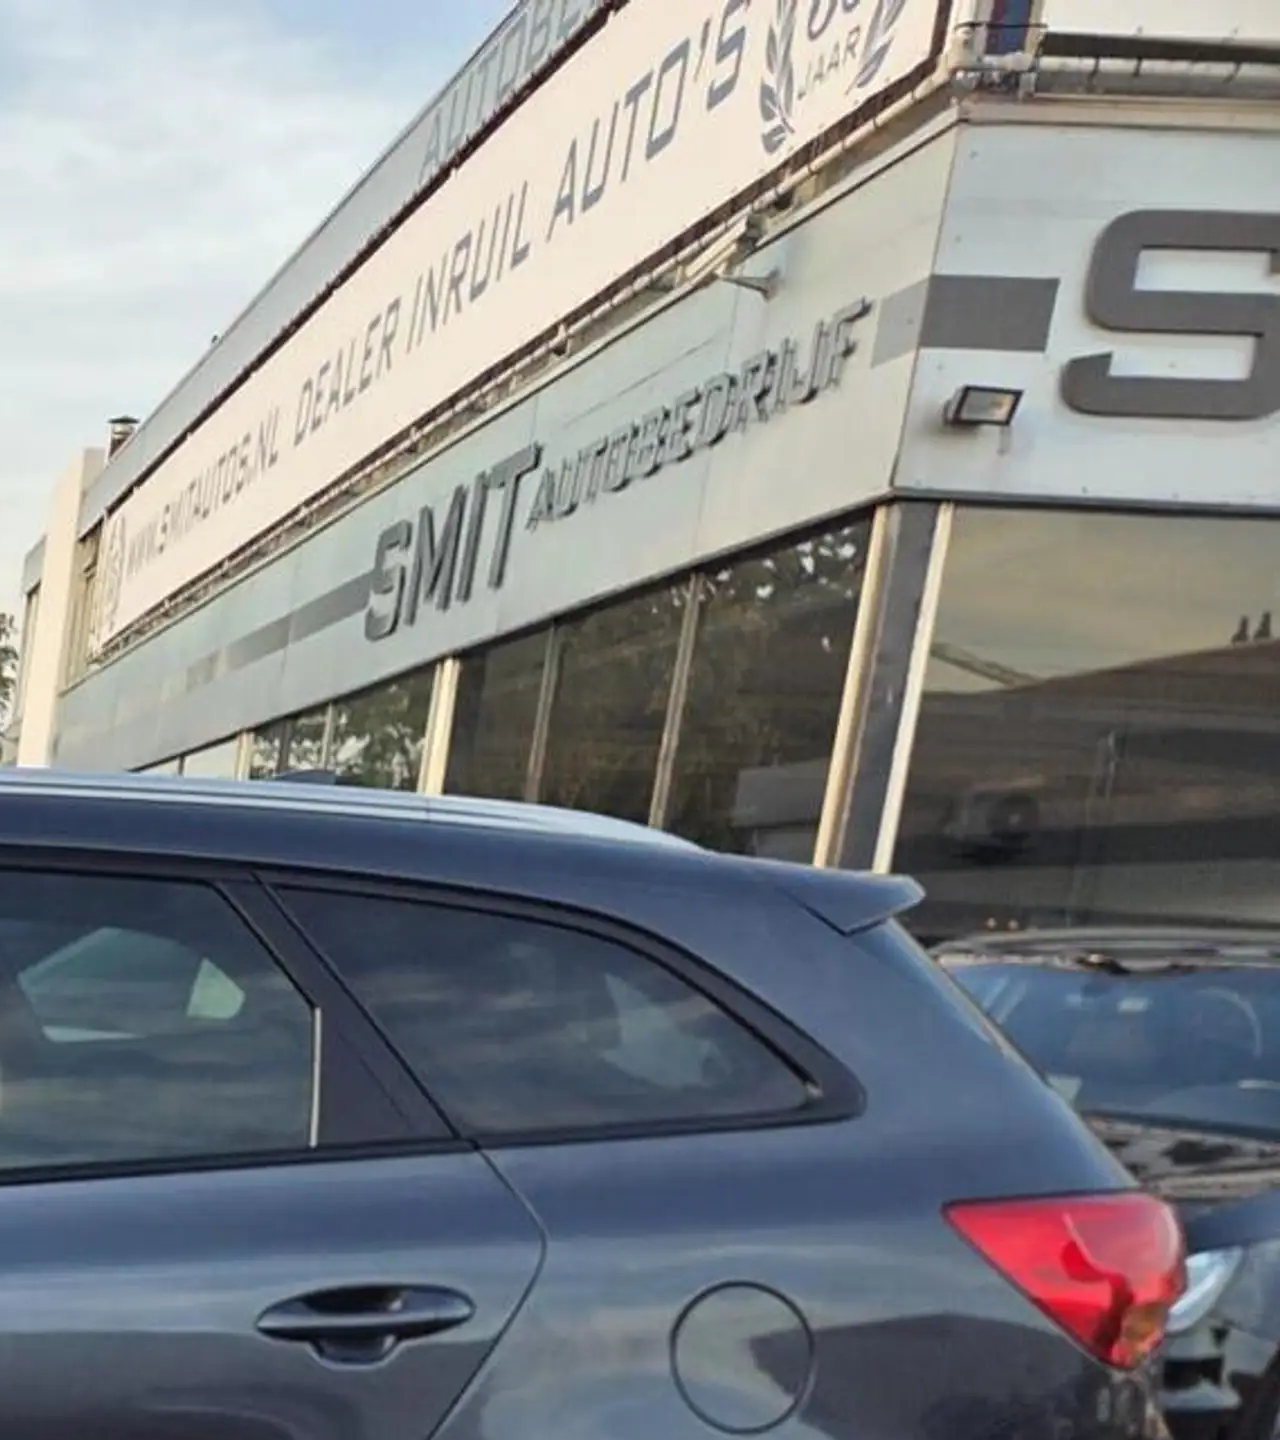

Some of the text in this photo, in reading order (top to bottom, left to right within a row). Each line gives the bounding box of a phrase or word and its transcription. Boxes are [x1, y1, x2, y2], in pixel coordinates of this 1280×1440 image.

[293, 296, 402, 447] DEALER
[406, 180, 531, 356] INRUIL
[546, 0, 752, 243] AUTO'S
[797, 24, 861, 101] JAAR
[364, 296, 874, 643] SMIT AUTOBEDRIJF
